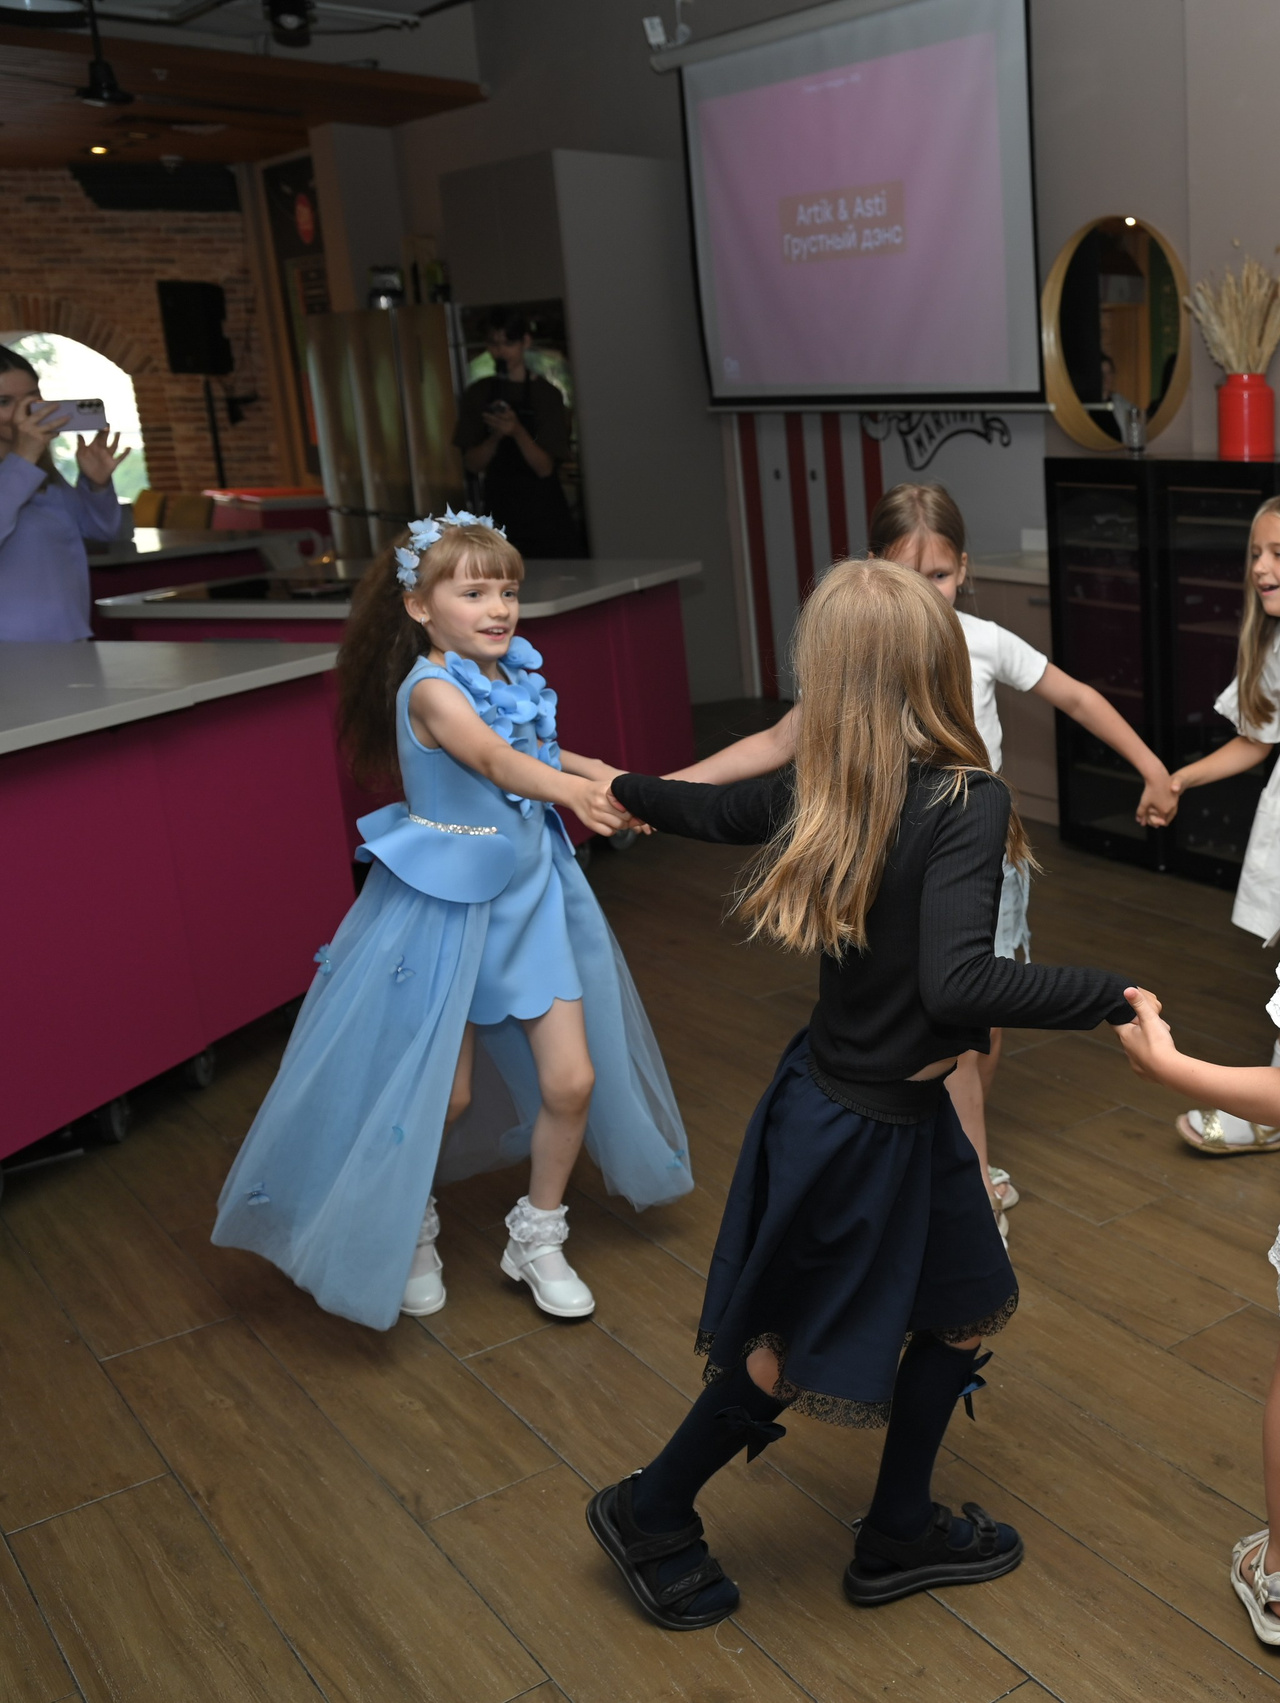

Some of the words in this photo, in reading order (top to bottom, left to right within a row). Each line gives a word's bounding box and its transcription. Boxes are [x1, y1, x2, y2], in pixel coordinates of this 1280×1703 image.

[797, 198, 834, 226] Artik
[837, 197, 849, 221] &
[853, 189, 887, 219] Asti
[783, 223, 858, 261] Грустный
[860, 224, 903, 252] дэнс
